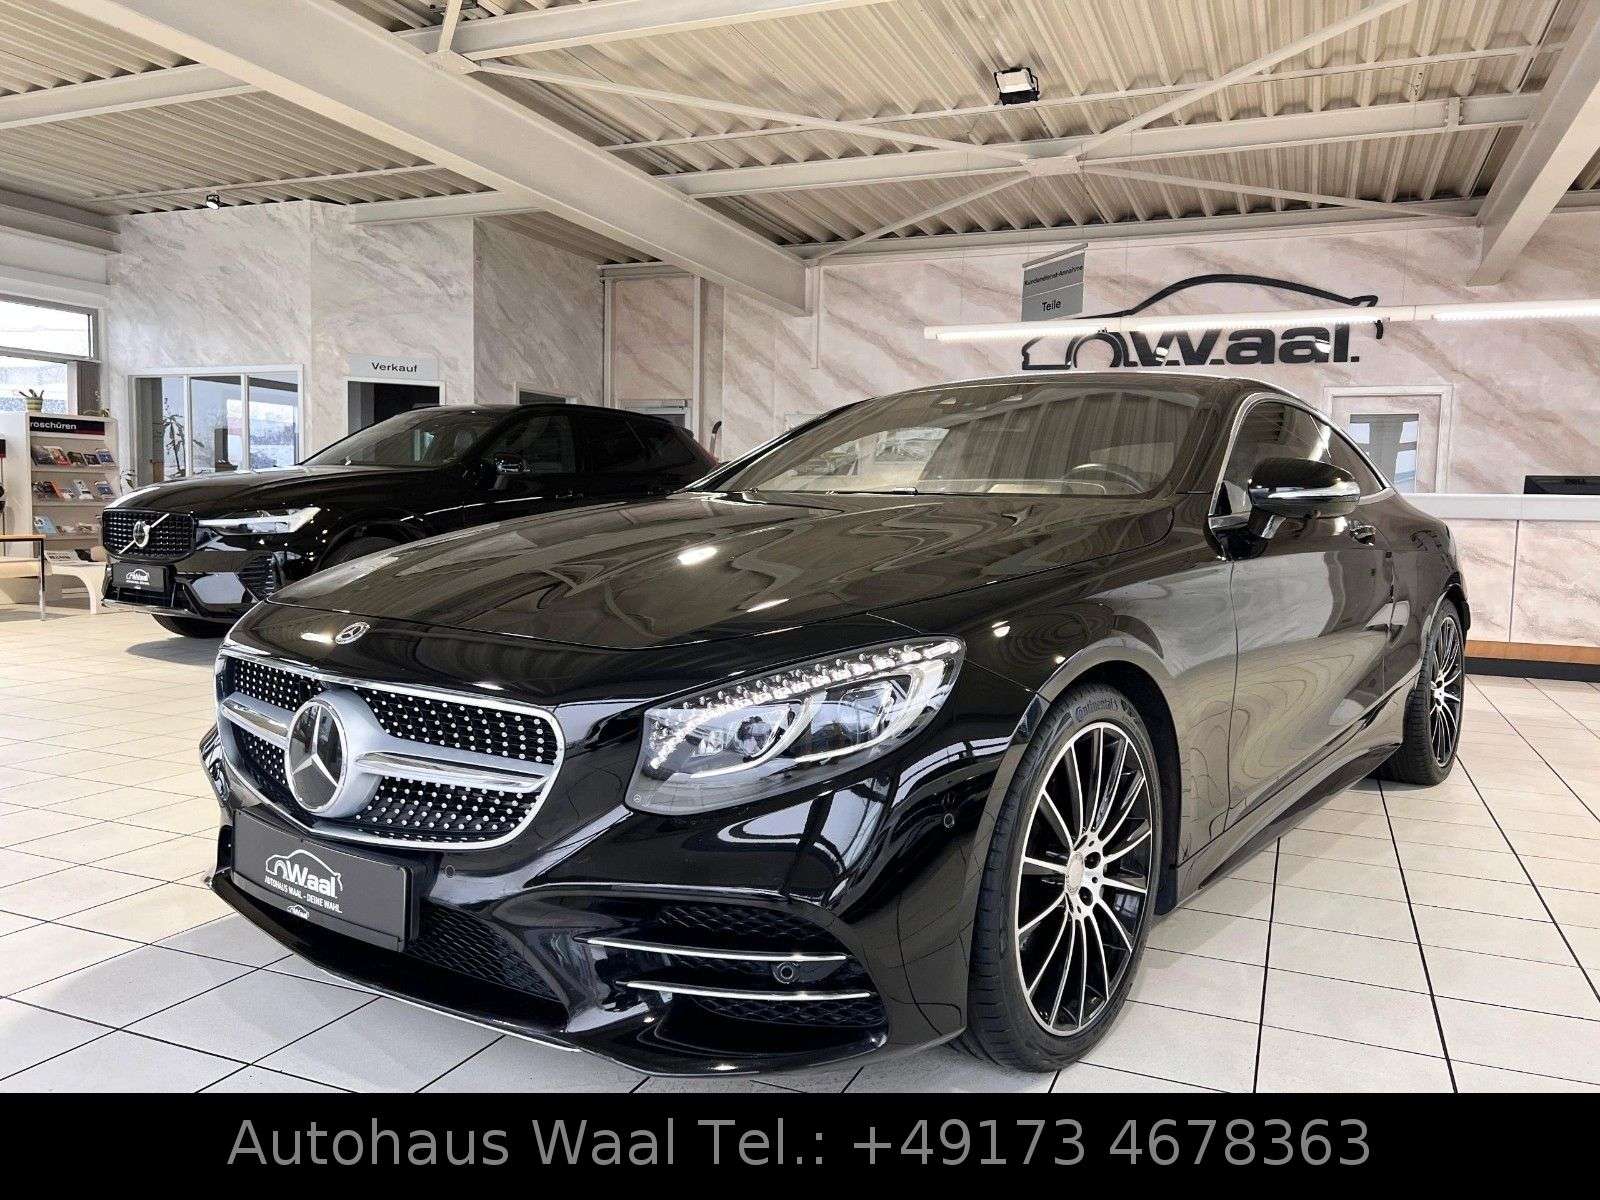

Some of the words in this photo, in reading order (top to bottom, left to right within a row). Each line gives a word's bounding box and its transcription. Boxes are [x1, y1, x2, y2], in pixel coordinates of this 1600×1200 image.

[1041, 300, 1062, 312] Teile
[371, 361, 418, 373] Verkauf
[30, 420, 77, 430] roschüren
[264, 875, 288, 893] AUTOHAUS
[288, 885, 303, 899] WAAL
[306, 893, 324, 907] DEINE
